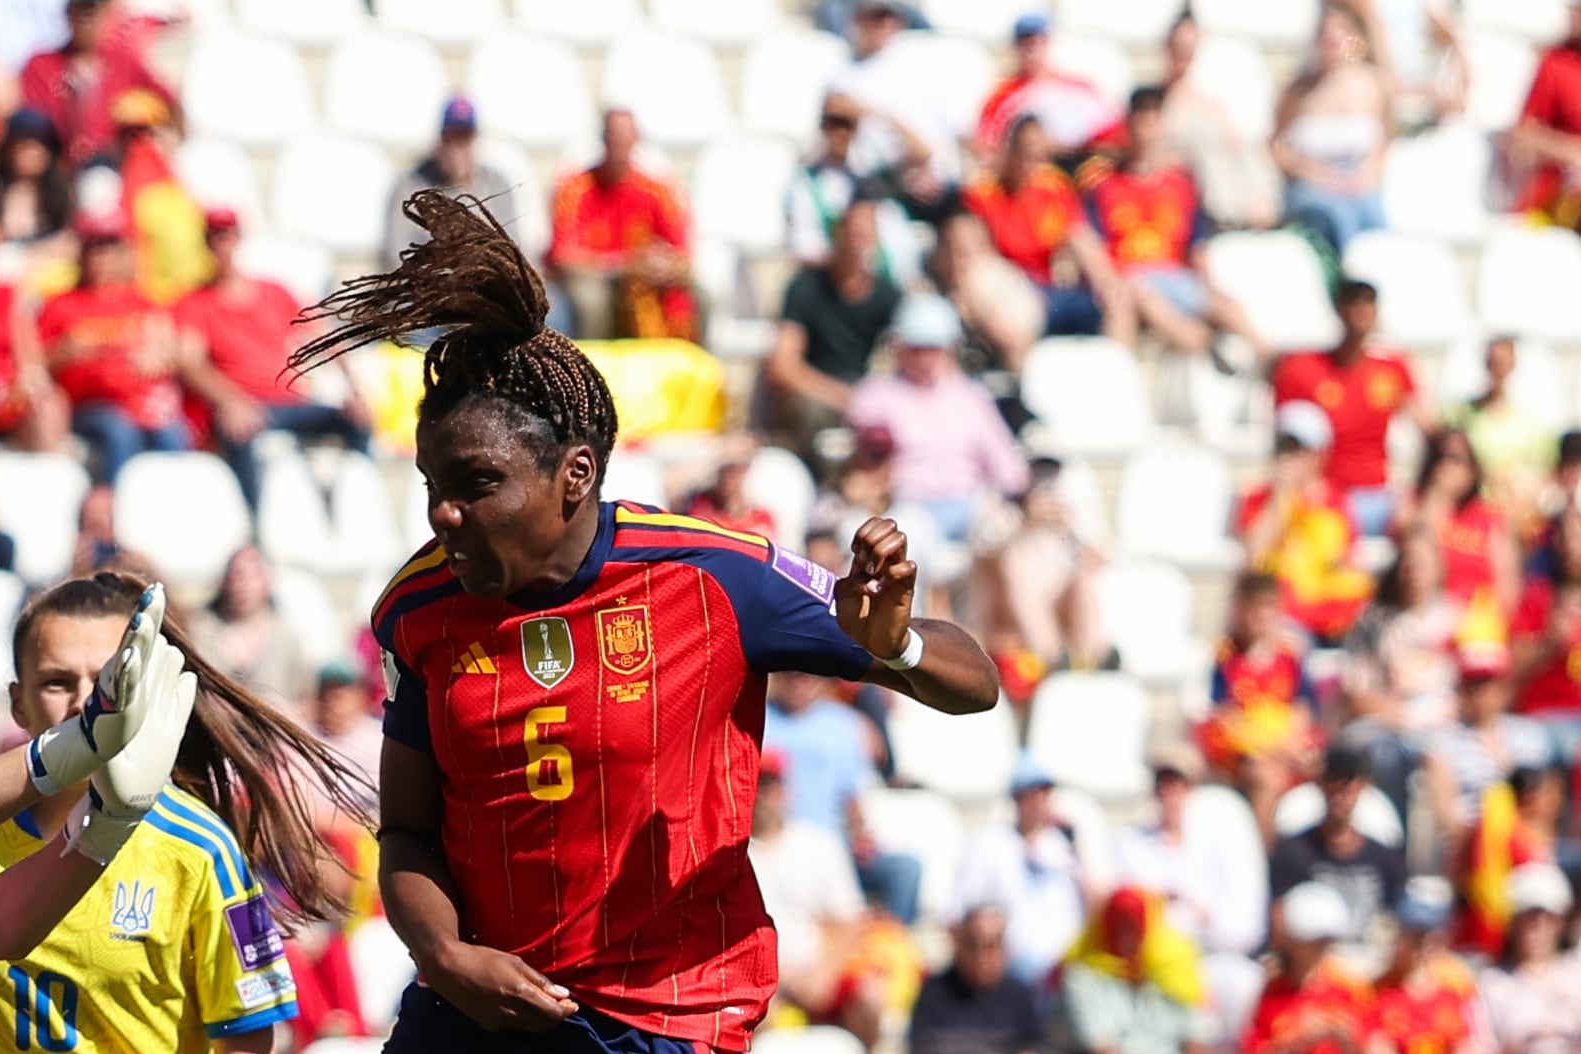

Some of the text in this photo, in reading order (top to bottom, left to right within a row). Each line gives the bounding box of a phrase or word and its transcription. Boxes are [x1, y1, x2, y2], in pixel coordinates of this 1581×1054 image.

[538, 660, 562, 671] FIFA
[524, 705, 574, 801] 6
[8, 965, 79, 1053] 10
